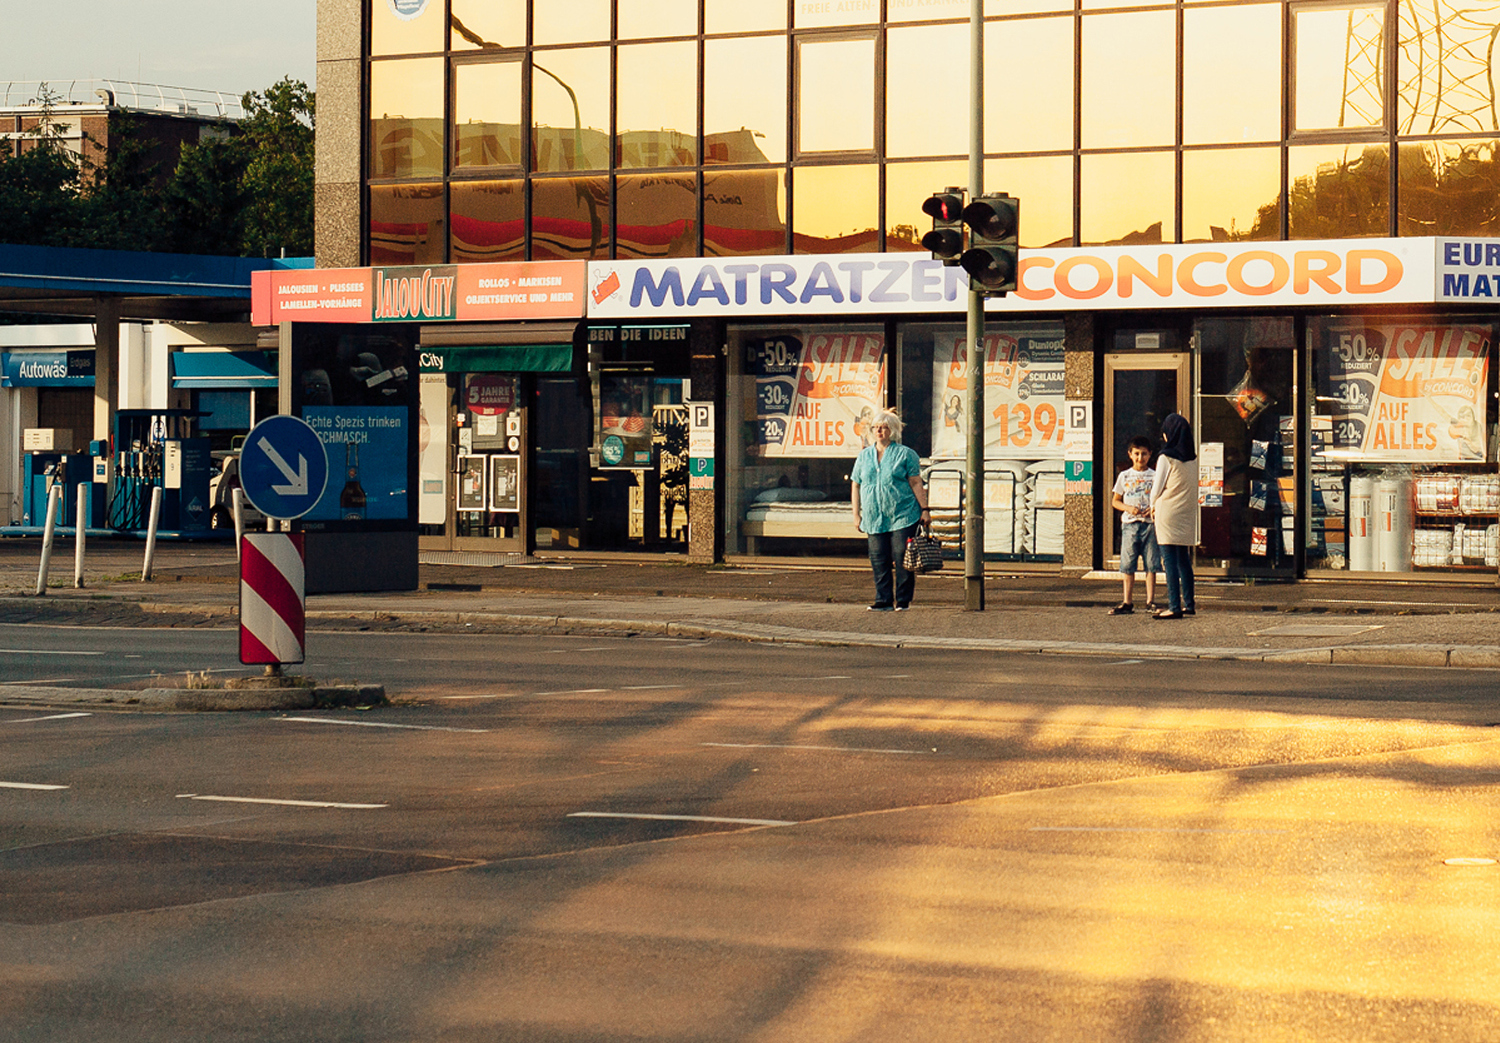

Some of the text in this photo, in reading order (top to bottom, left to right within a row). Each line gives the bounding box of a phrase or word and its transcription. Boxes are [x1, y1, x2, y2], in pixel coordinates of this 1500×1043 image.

[801, 2, 831, 15] FREIE
[479, 276, 563, 289] ROLLOS MARKISEN
[1013, 249, 1404, 301] CONCORD
[279, 283, 364, 295] JALOUSIEN PLISSEES
[280, 297, 362, 310] LAMELLEN-VORHÄNGE
[466, 292, 574, 305] OBJEKTSERVICE UND MEHR
[588, 328, 686, 342] BEN DIE IDEEN
[758, 340, 798, 367] -50%
[1332, 334, 1380, 362] -50%
[952, 338, 1017, 378] SLE!
[1388, 329, 1490, 385] SALE!
[20, 360, 84, 379] Autowäs
[1340, 362, 1373, 370] REDUZIERT
[985, 375, 1011, 385] ONCORD
[468, 385, 510, 404] 5 JAHRE
[759, 384, 790, 405] -30%
[1332, 382, 1369, 405] -30%
[1432, 382, 1476, 399] CONCORD
[796, 403, 821, 420] AUF
[1378, 402, 1409, 421] AUF
[306, 415, 401, 430] Echte Spezis trinken
[761, 421, 784, 437] -20%
[1335, 422, 1362, 440] -20%
[316, 431, 371, 444] SCHMASCH.
[792, 421, 845, 447] ALLES
[1373, 422, 1438, 451] ALLES
[697, 459, 708, 472] P
[1073, 461, 1084, 476] P
